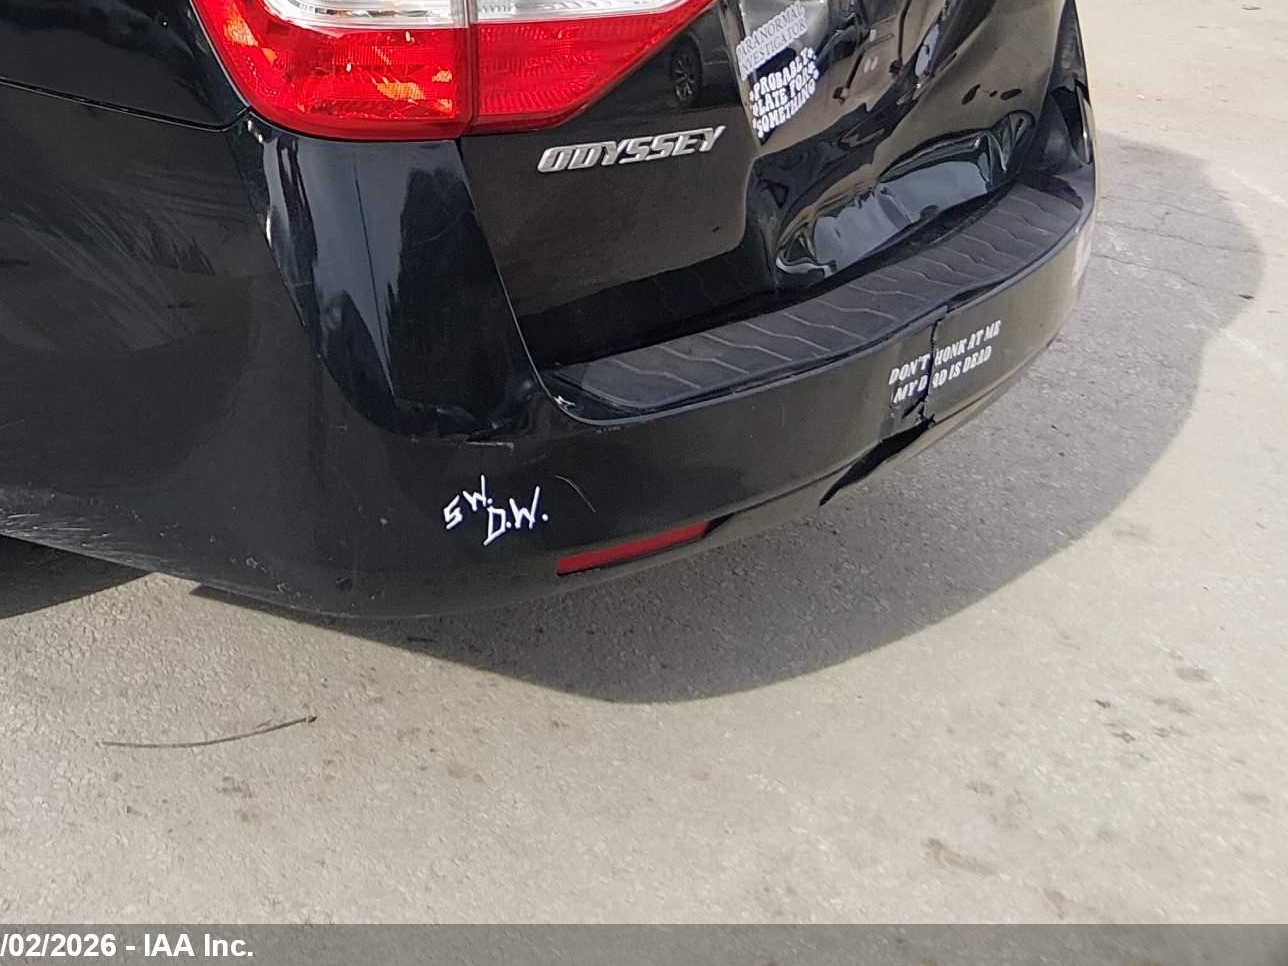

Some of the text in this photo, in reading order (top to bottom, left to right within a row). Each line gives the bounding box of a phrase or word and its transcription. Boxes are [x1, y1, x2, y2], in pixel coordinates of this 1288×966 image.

[736, 2, 805, 64] PARANORMAL
[753, 48, 811, 101] PROBABLY
[757, 67, 810, 115] LATE FOR
[757, 79, 816, 138] SOMETHING
[538, 126, 726, 172] ODYSSEY
[889, 320, 1001, 385] DON'T HONK AT ME
[893, 381, 918, 403] MY
[948, 361, 962, 380] IS
[962, 346, 992, 373] DEAD
